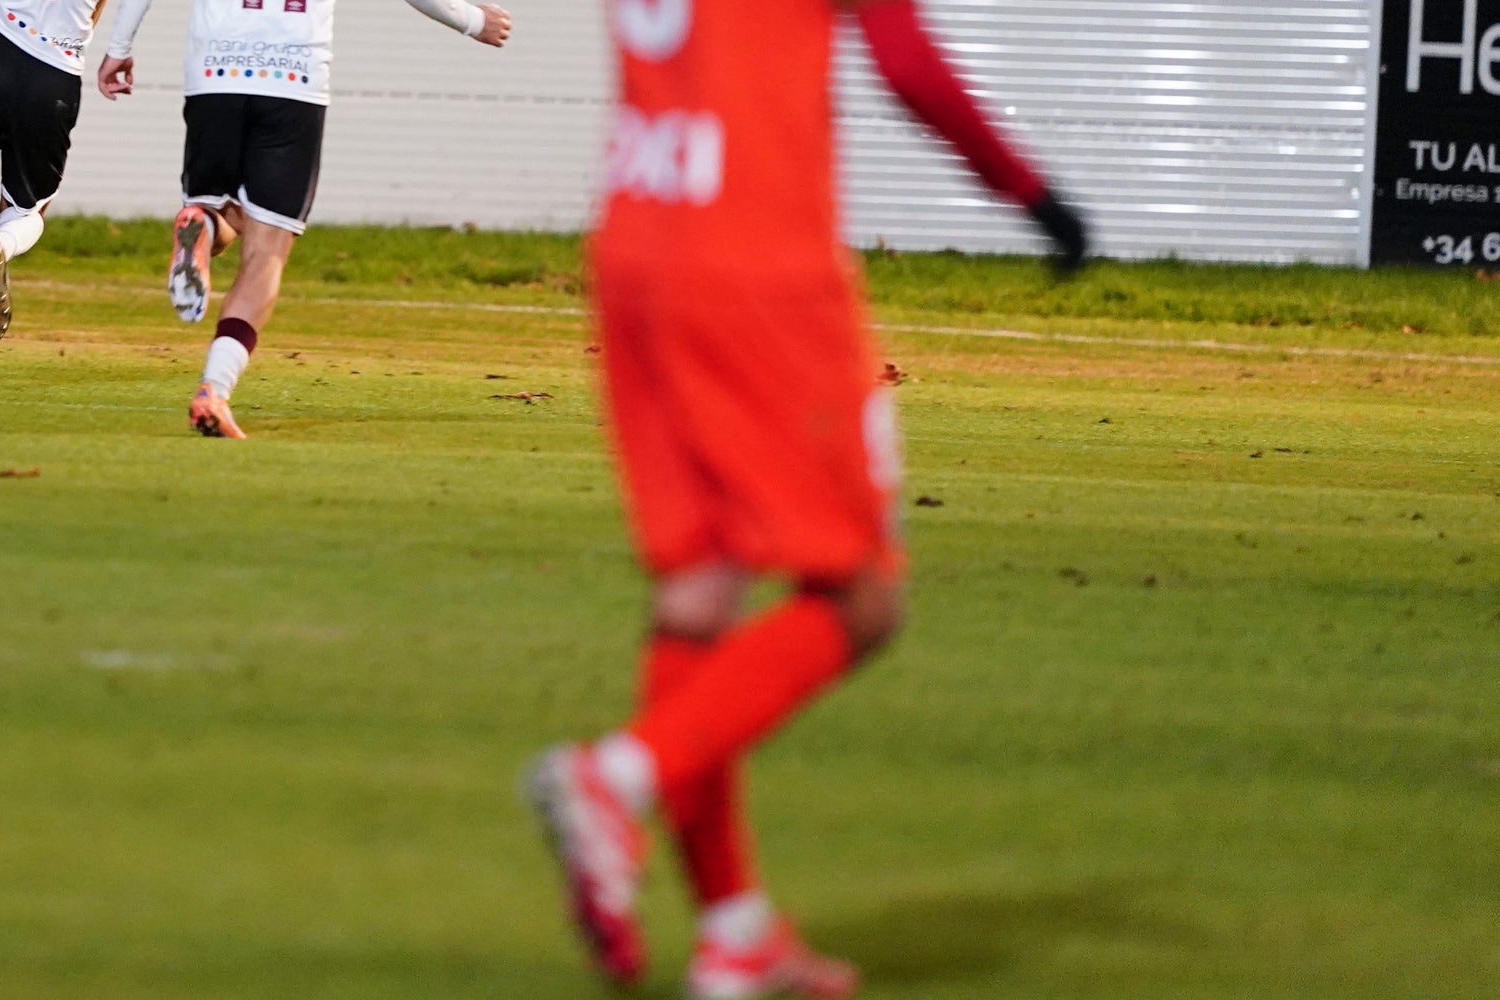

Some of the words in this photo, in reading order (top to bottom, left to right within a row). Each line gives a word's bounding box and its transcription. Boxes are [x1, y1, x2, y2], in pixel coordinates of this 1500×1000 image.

[203, 54, 310, 74] EMPRESARIAL
[1408, 140, 1457, 172] TU
[1462, 142, 1500, 173] AL
[1395, 177, 1489, 205] Empresa
